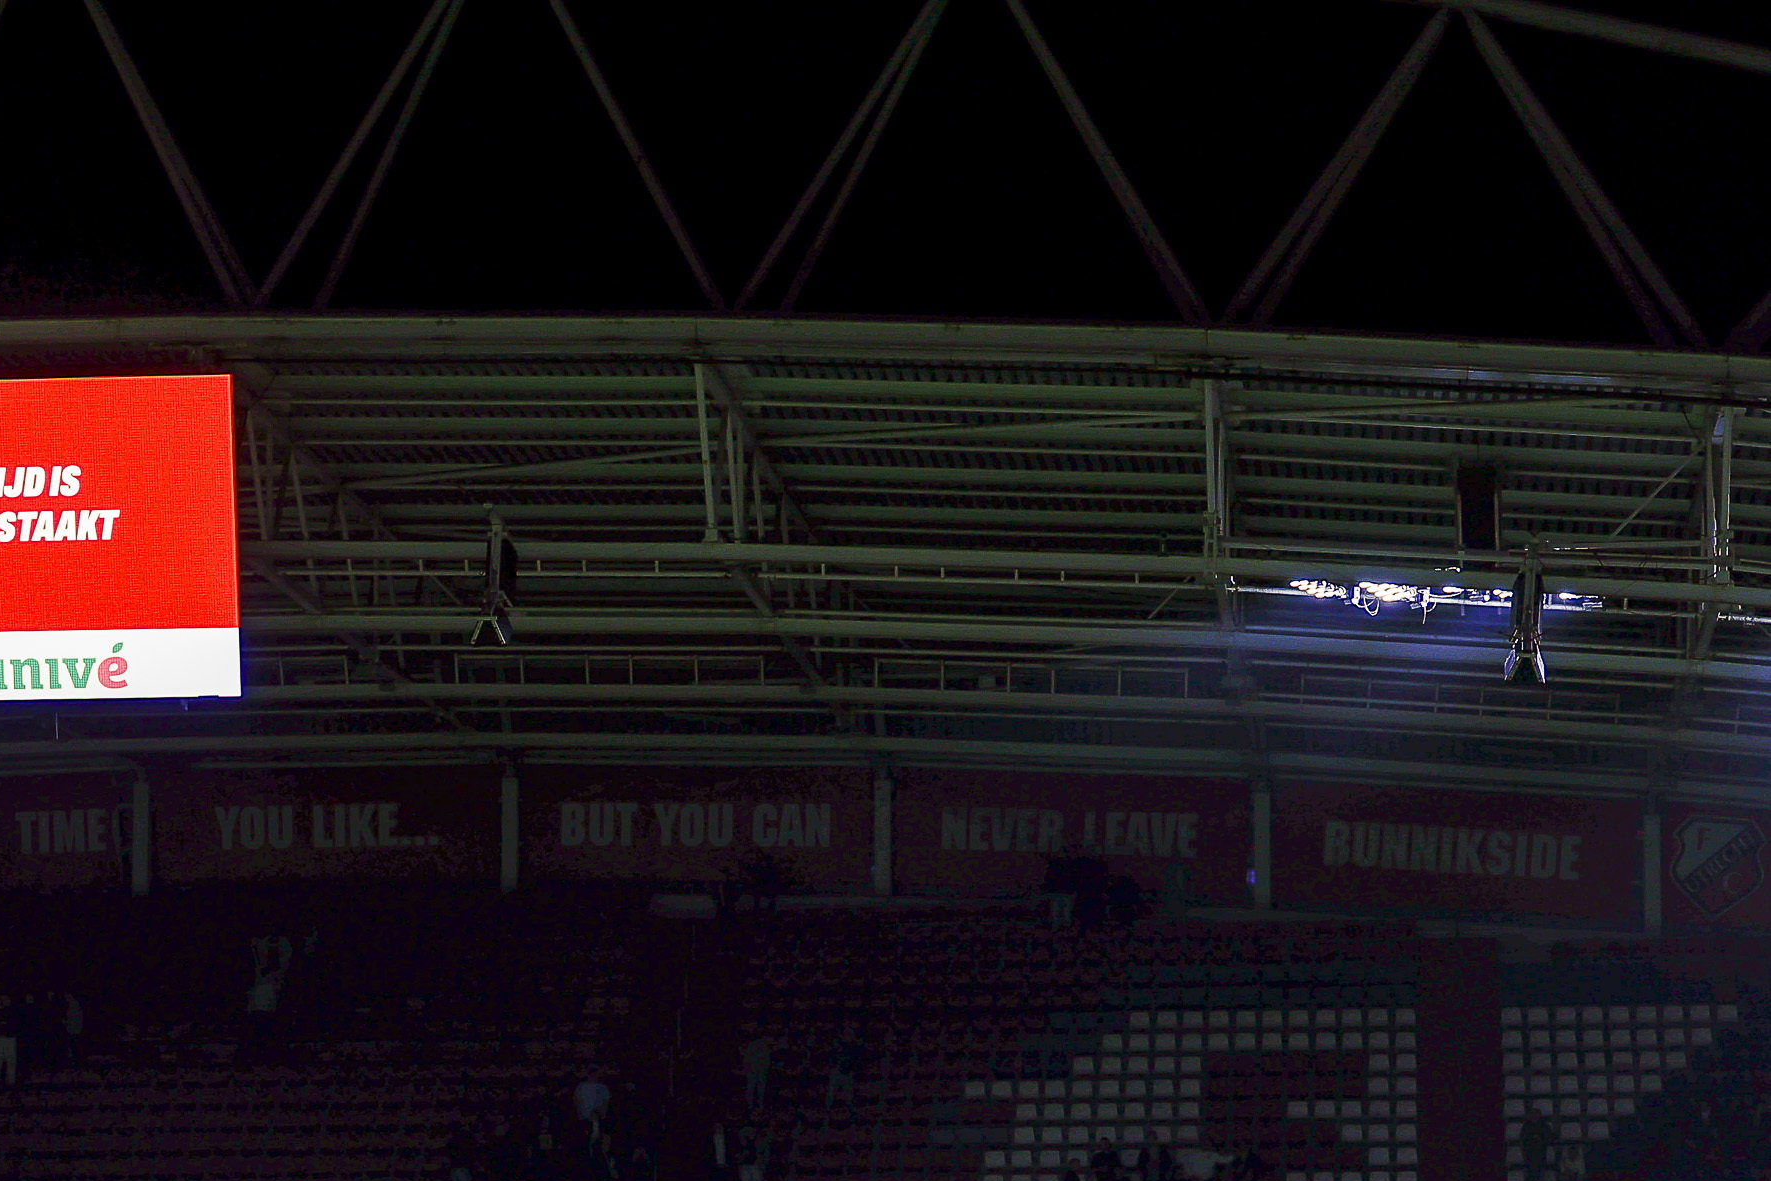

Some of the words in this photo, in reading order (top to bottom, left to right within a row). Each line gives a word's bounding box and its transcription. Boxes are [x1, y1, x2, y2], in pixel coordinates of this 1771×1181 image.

[49, 465, 82, 496] IS
[14, 806, 108, 855] TIME
[215, 804, 294, 850] YOU
[560, 802, 631, 846] BUT
[650, 802, 731, 848] YOU
[751, 804, 833, 850] CAN
[941, 806, 1064, 856] NEVER
[1081, 810, 1200, 860] LEAVE
[1320, 818, 1583, 882] BUNNIKSIDE
